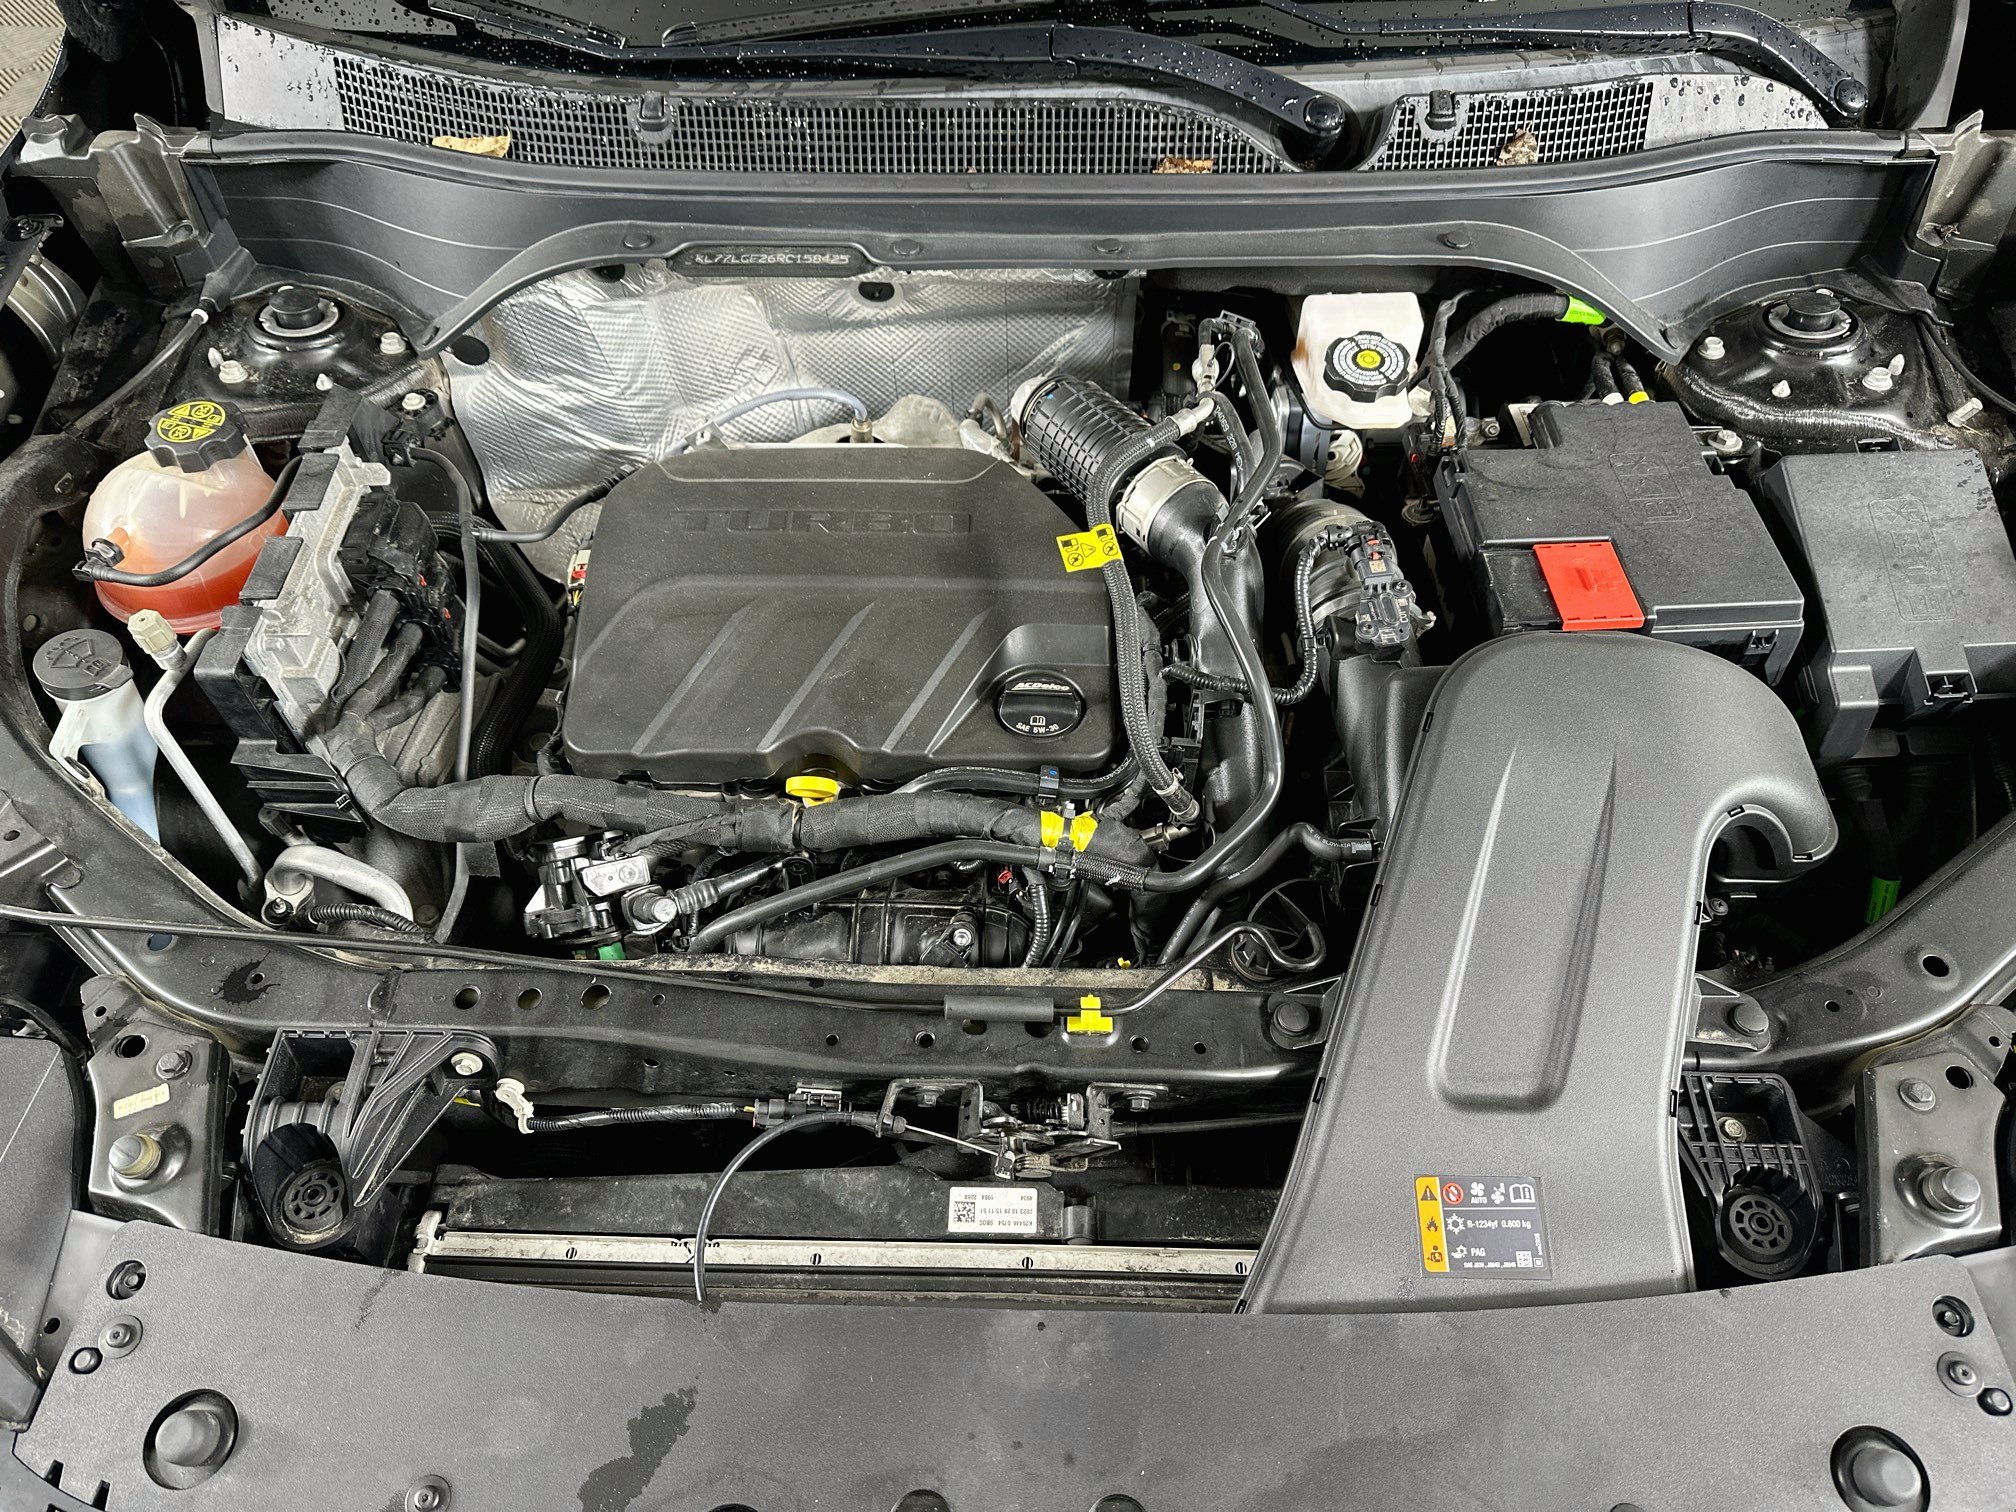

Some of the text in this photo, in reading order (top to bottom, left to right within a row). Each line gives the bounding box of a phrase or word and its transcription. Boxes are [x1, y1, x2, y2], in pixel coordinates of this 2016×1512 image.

[671, 508, 971, 534] TURBO
[1011, 682, 1071, 691] ACDelco
[1016, 722, 1060, 733] SAE 5W-30
[1470, 1196, 1487, 1204] AUTO
[1467, 1220, 1498, 1230] R-1234yf
[1522, 1220, 1532, 1230] kg
[1470, 1247, 1486, 1257] PAG
